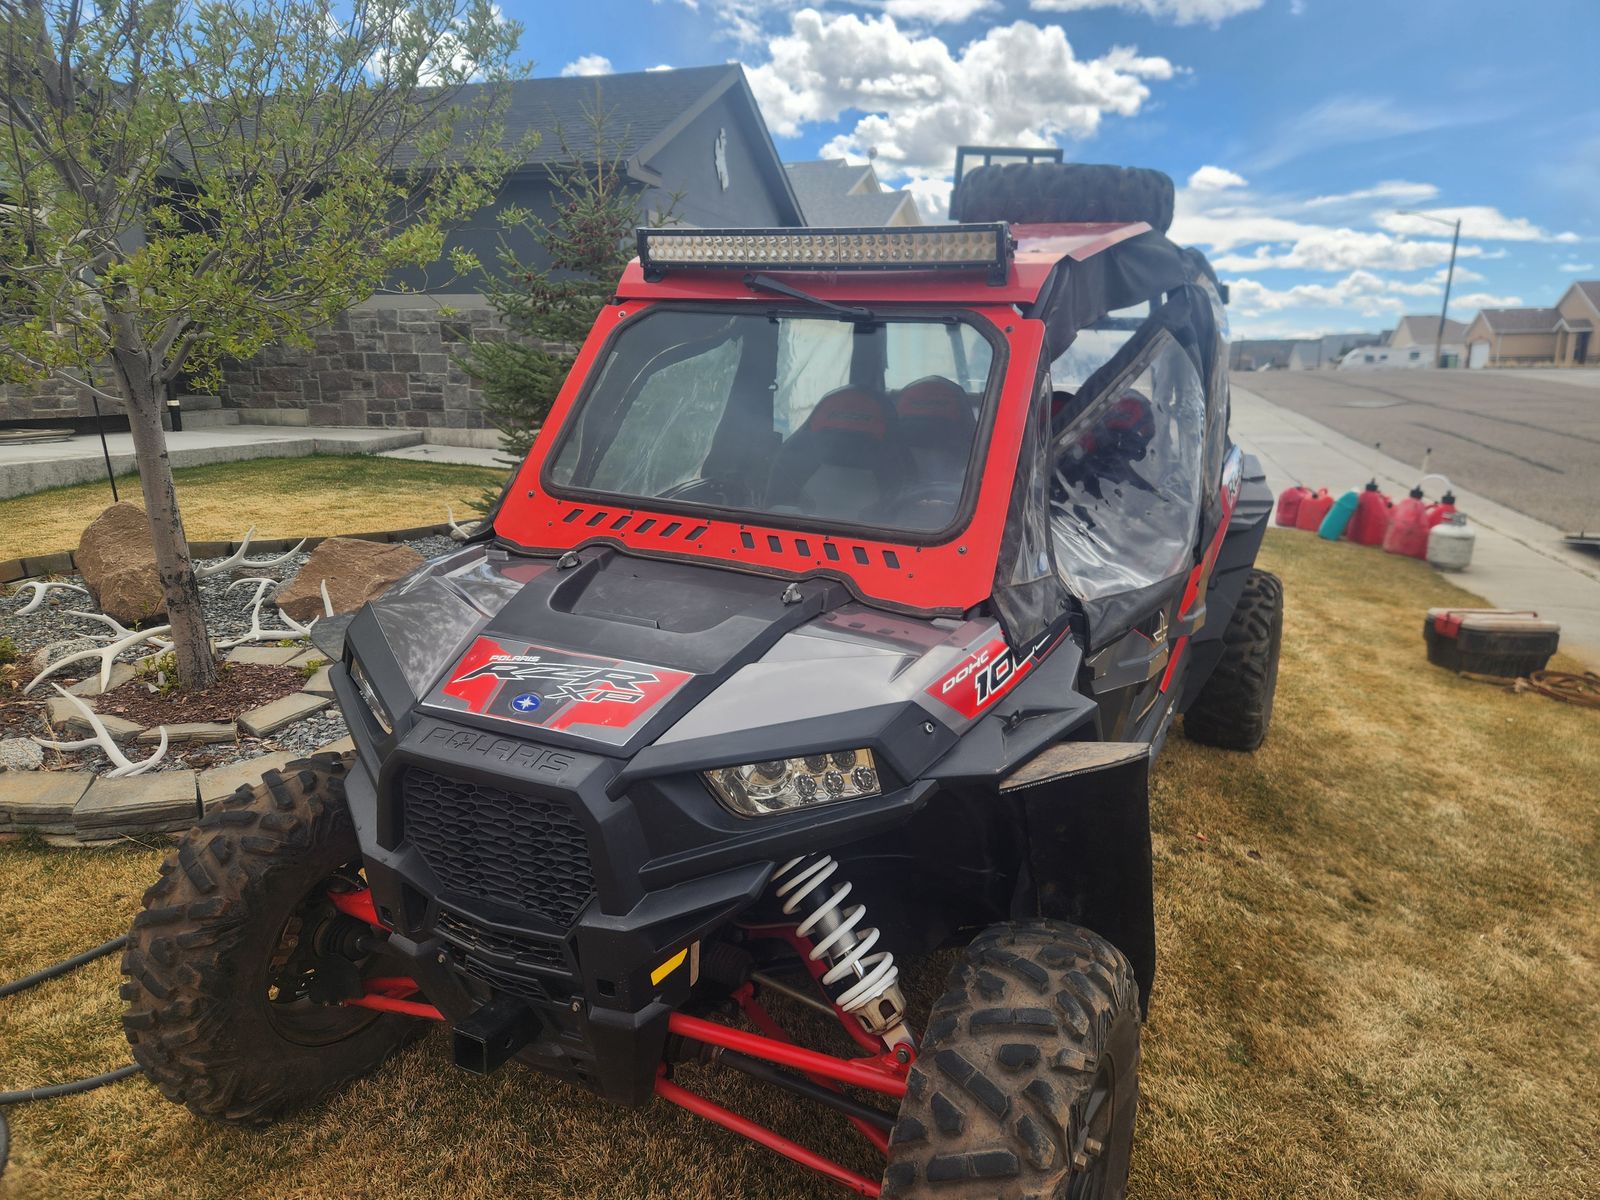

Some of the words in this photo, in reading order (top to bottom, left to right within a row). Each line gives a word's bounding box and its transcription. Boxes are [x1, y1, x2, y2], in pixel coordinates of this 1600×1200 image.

[489, 654, 541, 663] POLARIS
[942, 650, 989, 694] DOHC
[451, 662, 660, 693] RZR
[544, 685, 645, 704] XP
[420, 727, 576, 772] POLARIS
